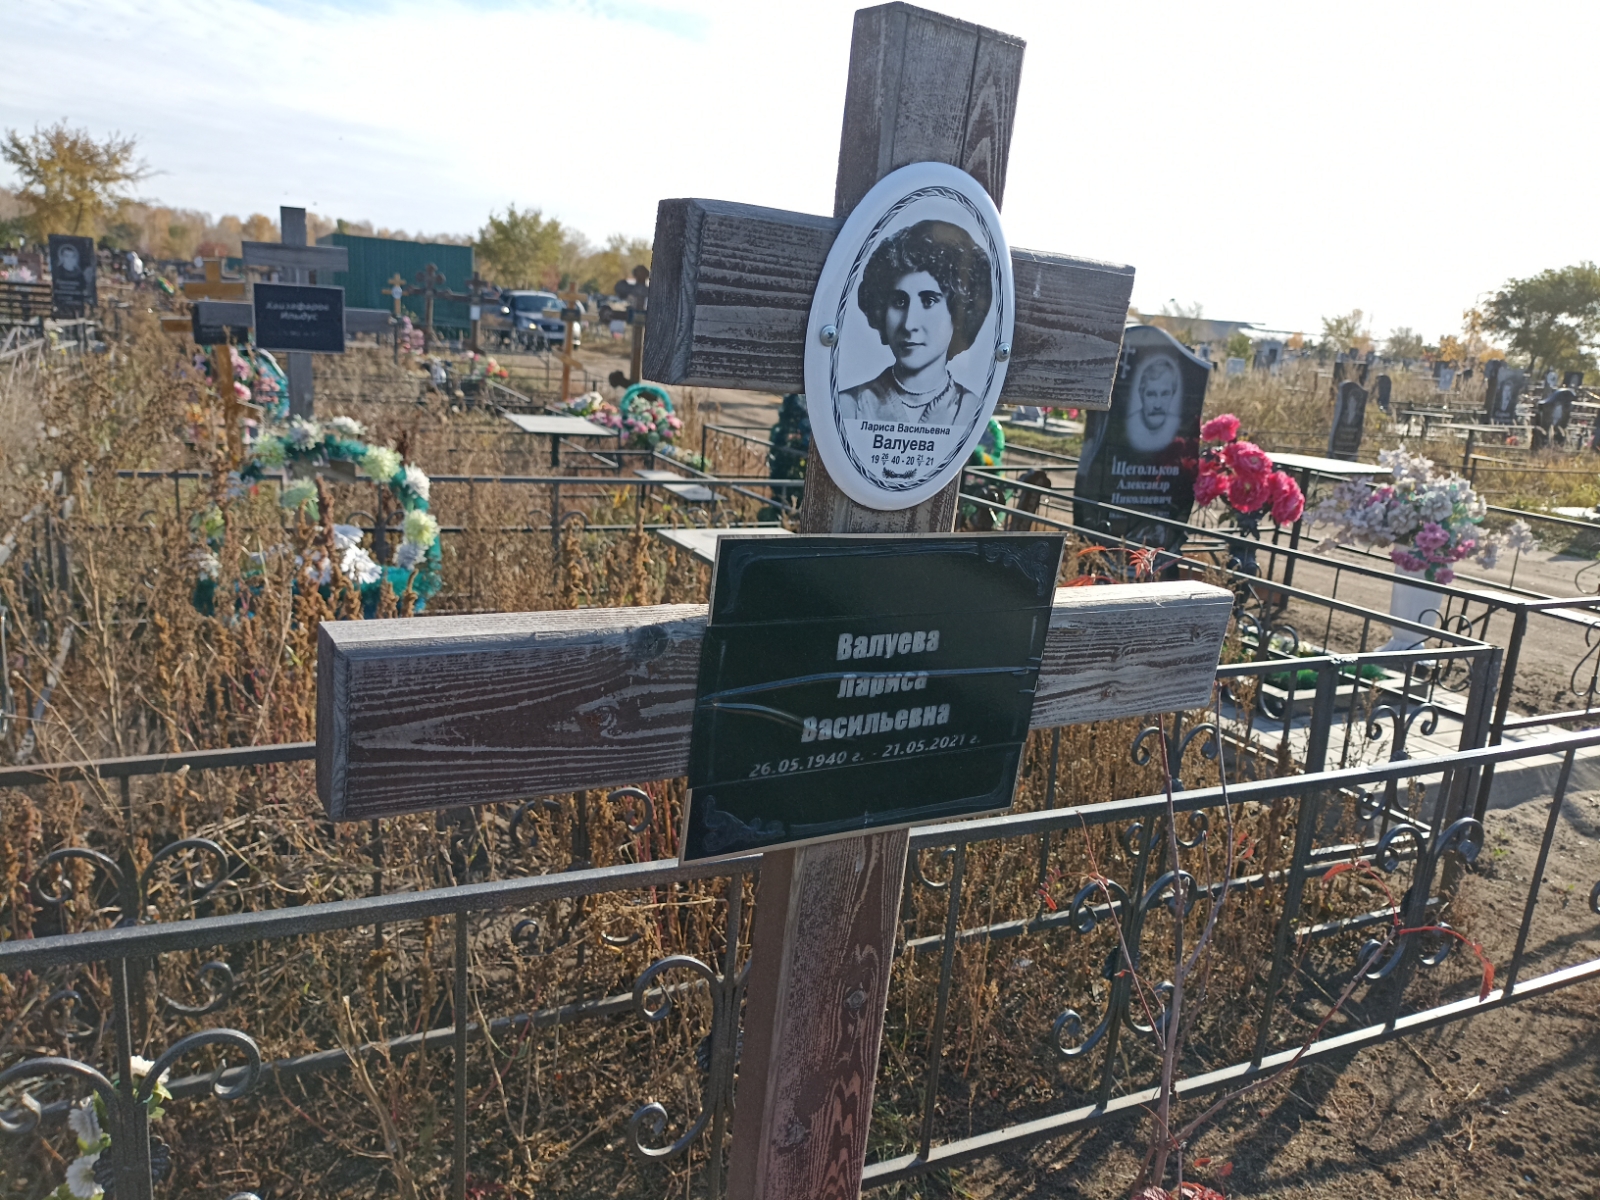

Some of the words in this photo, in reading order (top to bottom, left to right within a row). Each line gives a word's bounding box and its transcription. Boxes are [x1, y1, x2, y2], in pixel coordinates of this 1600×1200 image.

[861, 421, 895, 433] Лариса
[897, 423, 951, 435] Васильевна
[873, 434, 935, 454] Валуева
[891, 455, 900, 465] 40
[1111, 456, 1180, 477] Щегольков
[1117, 479, 1170, 493] Александр
[1111, 492, 1172, 505] Николаевич
[836, 630, 940, 661] Валуева
[836, 671, 930, 698] Лариса
[801, 703, 951, 743] Васильевна
[749, 750, 847, 778] 26.05.1940
[881, 733, 965, 758] 21.05.2021
